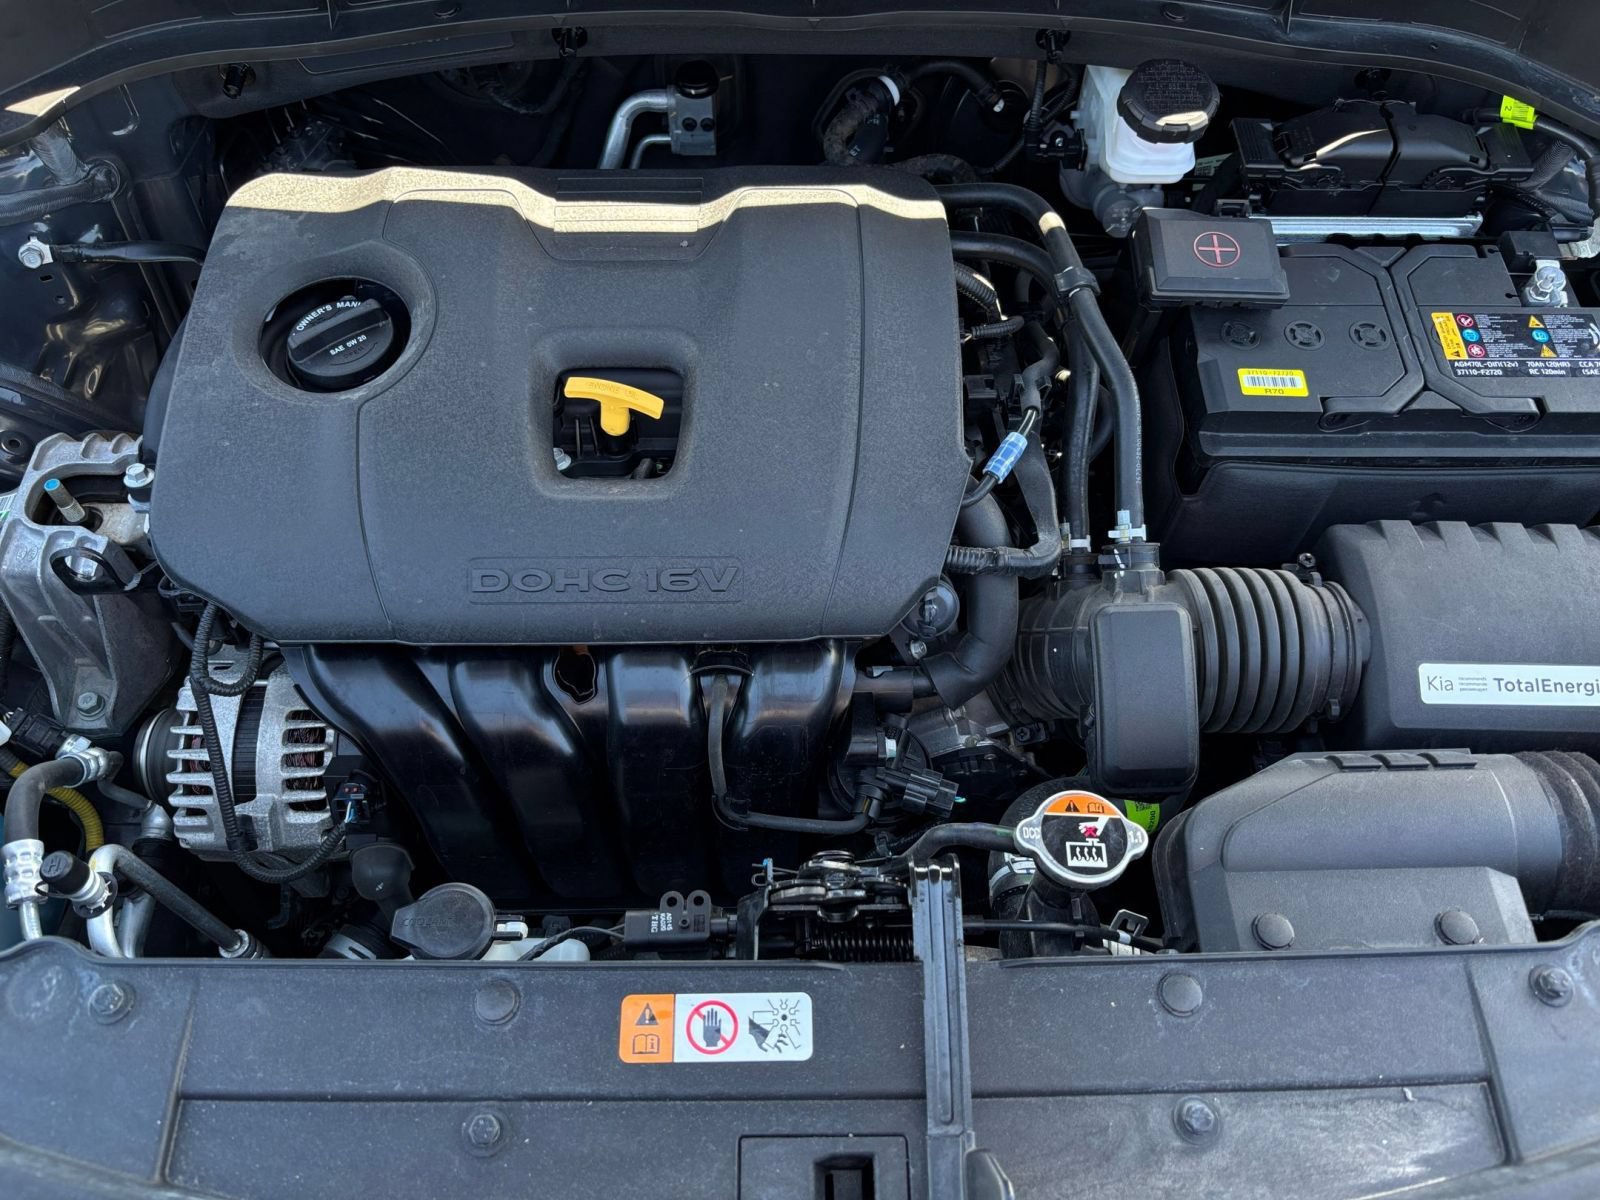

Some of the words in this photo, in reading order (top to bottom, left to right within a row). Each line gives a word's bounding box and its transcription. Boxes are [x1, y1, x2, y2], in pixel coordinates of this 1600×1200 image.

[296, 304, 333, 331] OWNER'S
[336, 301, 361, 309] MAN
[329, 344, 346, 356] SAE
[346, 338, 358, 348] 0W
[357, 334, 367, 342] 20
[471, 567, 631, 593] DOHC
[646, 566, 738, 593] 16V
[1426, 675, 1454, 692] Kia
[1493, 677, 1600, 697] TotalEnergi
[1128, 830, 1143, 844] 1.1
[47, 857, 62, 874] H
